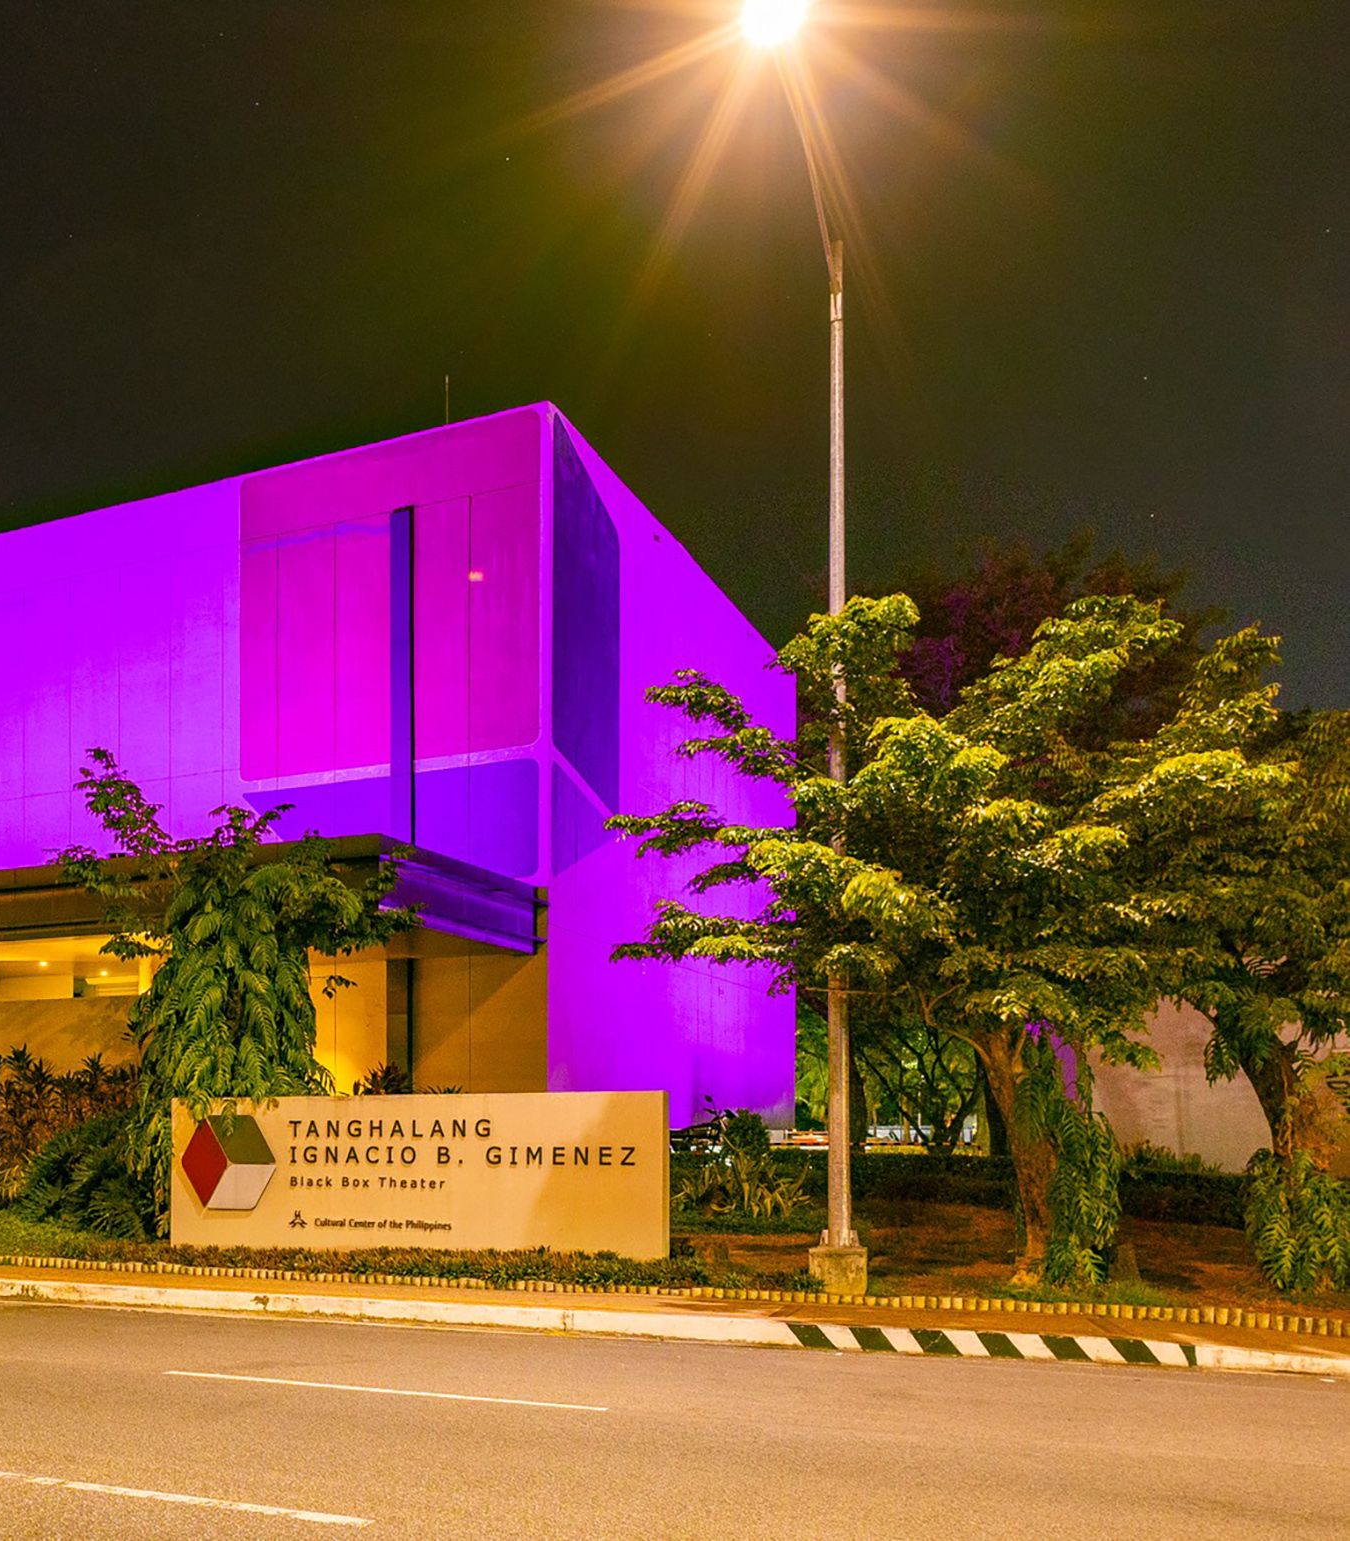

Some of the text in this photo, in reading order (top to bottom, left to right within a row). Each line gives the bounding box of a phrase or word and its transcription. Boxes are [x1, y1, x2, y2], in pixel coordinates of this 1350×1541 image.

[288, 1118, 492, 1139] TANGHALANG
[288, 1145, 637, 1167] IGNACIO B. GIMENEZ
[289, 1175, 446, 1190] Black Box Theater
[314, 1217, 452, 1232] Cultural Center of the Philippines
